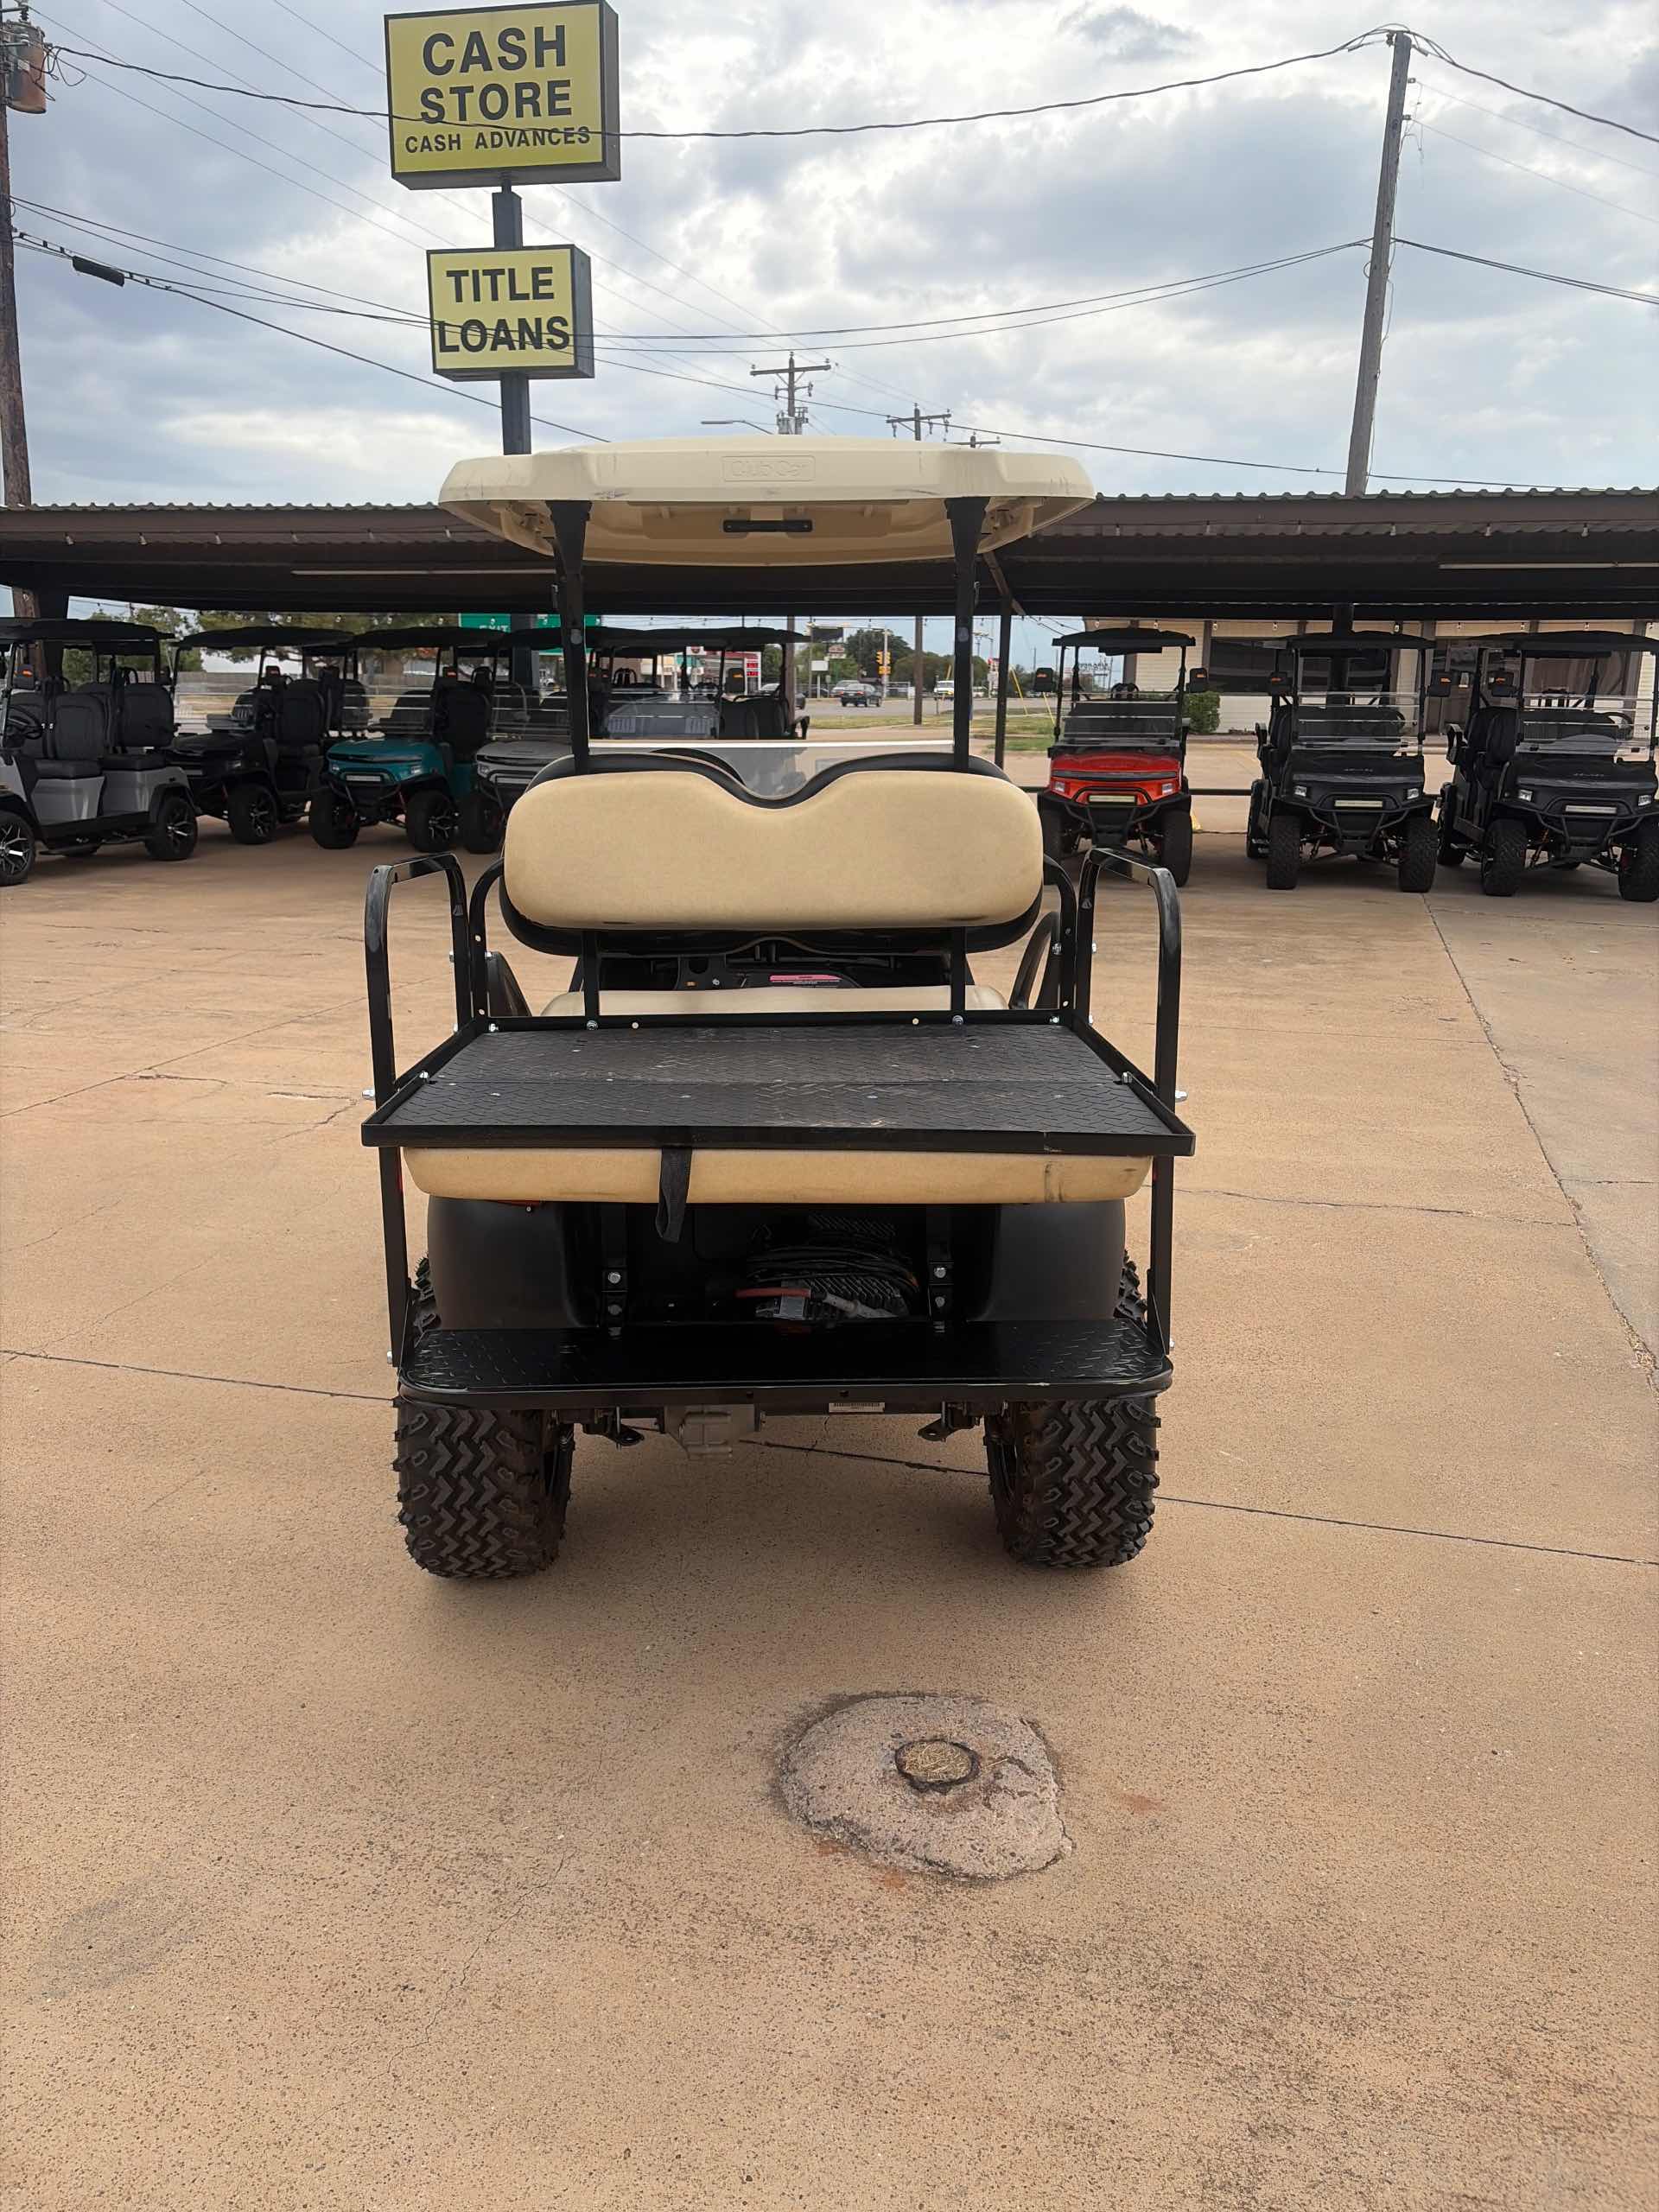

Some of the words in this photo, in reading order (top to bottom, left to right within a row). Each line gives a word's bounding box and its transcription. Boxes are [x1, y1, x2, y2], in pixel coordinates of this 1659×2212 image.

[423, 24, 566, 75] CASH
[420, 79, 572, 124] STORE
[405, 133, 461, 153] CASH
[475, 126, 590, 149] ADVANCES
[446, 266, 555, 302] TITLE
[438, 315, 570, 353] LOANS
